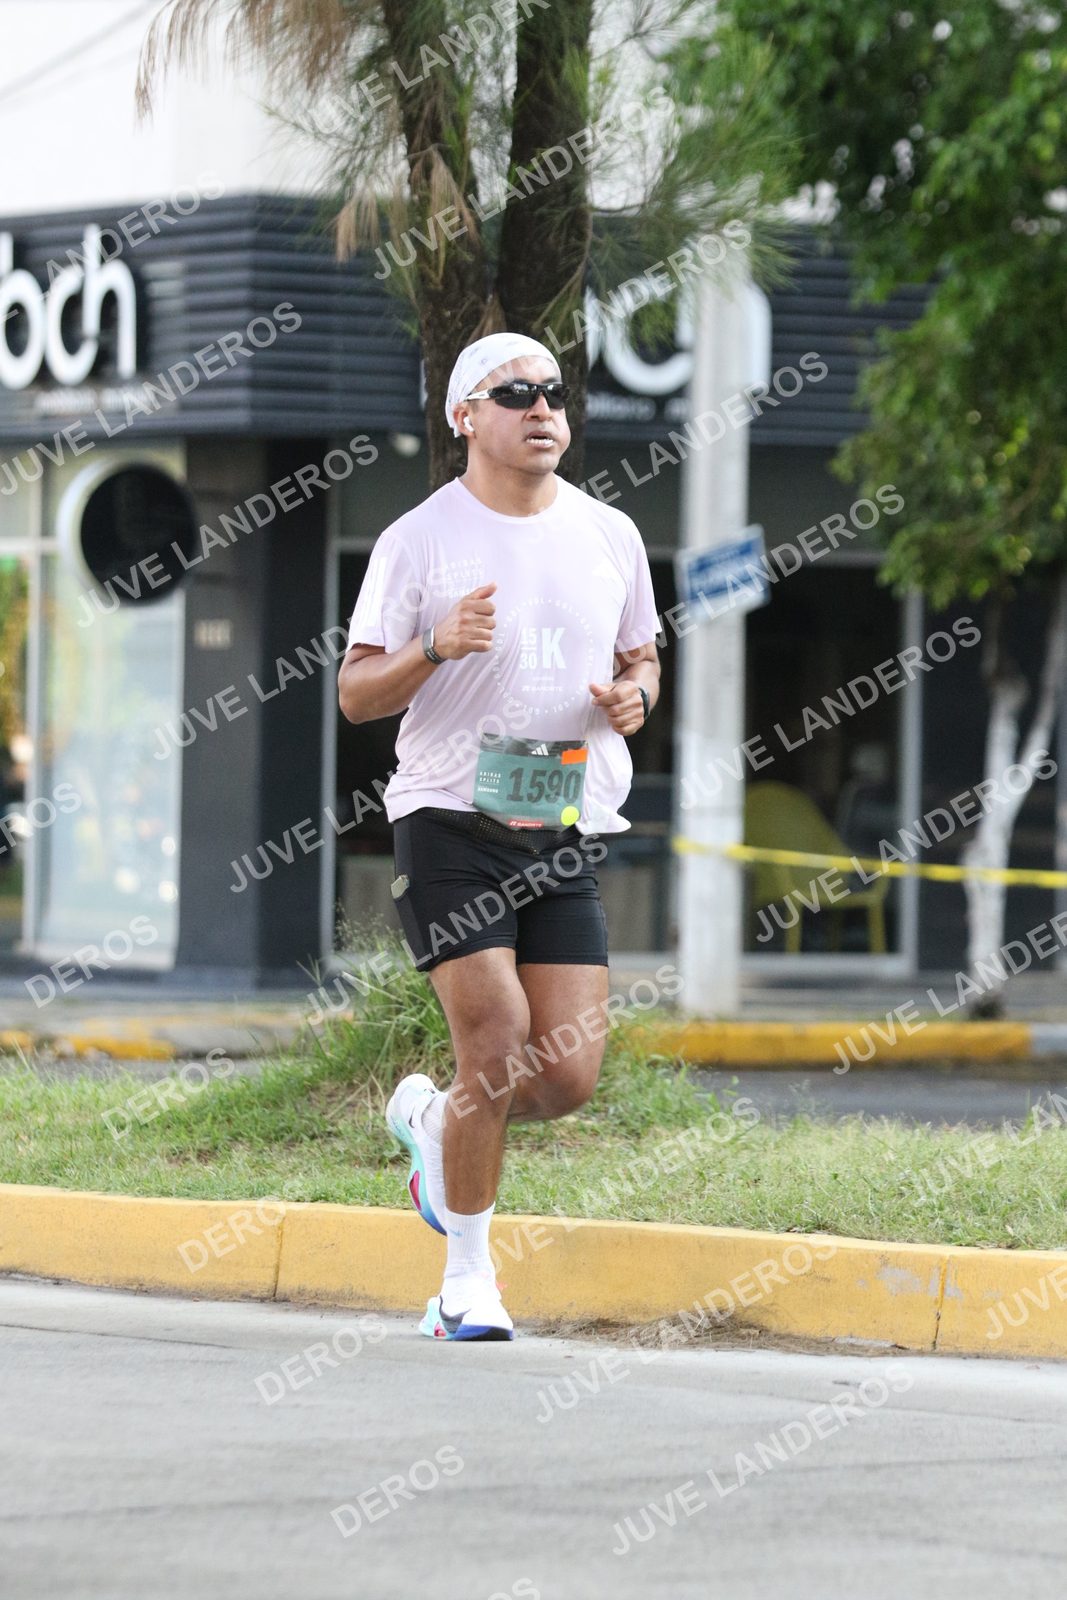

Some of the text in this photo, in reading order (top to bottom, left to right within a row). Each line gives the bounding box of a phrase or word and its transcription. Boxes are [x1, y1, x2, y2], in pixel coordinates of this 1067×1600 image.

[520, 627, 537, 645] 15
[542, 627, 567, 669] K
[519, 652, 538, 669] 30
[506, 767, 582, 804] 1590
